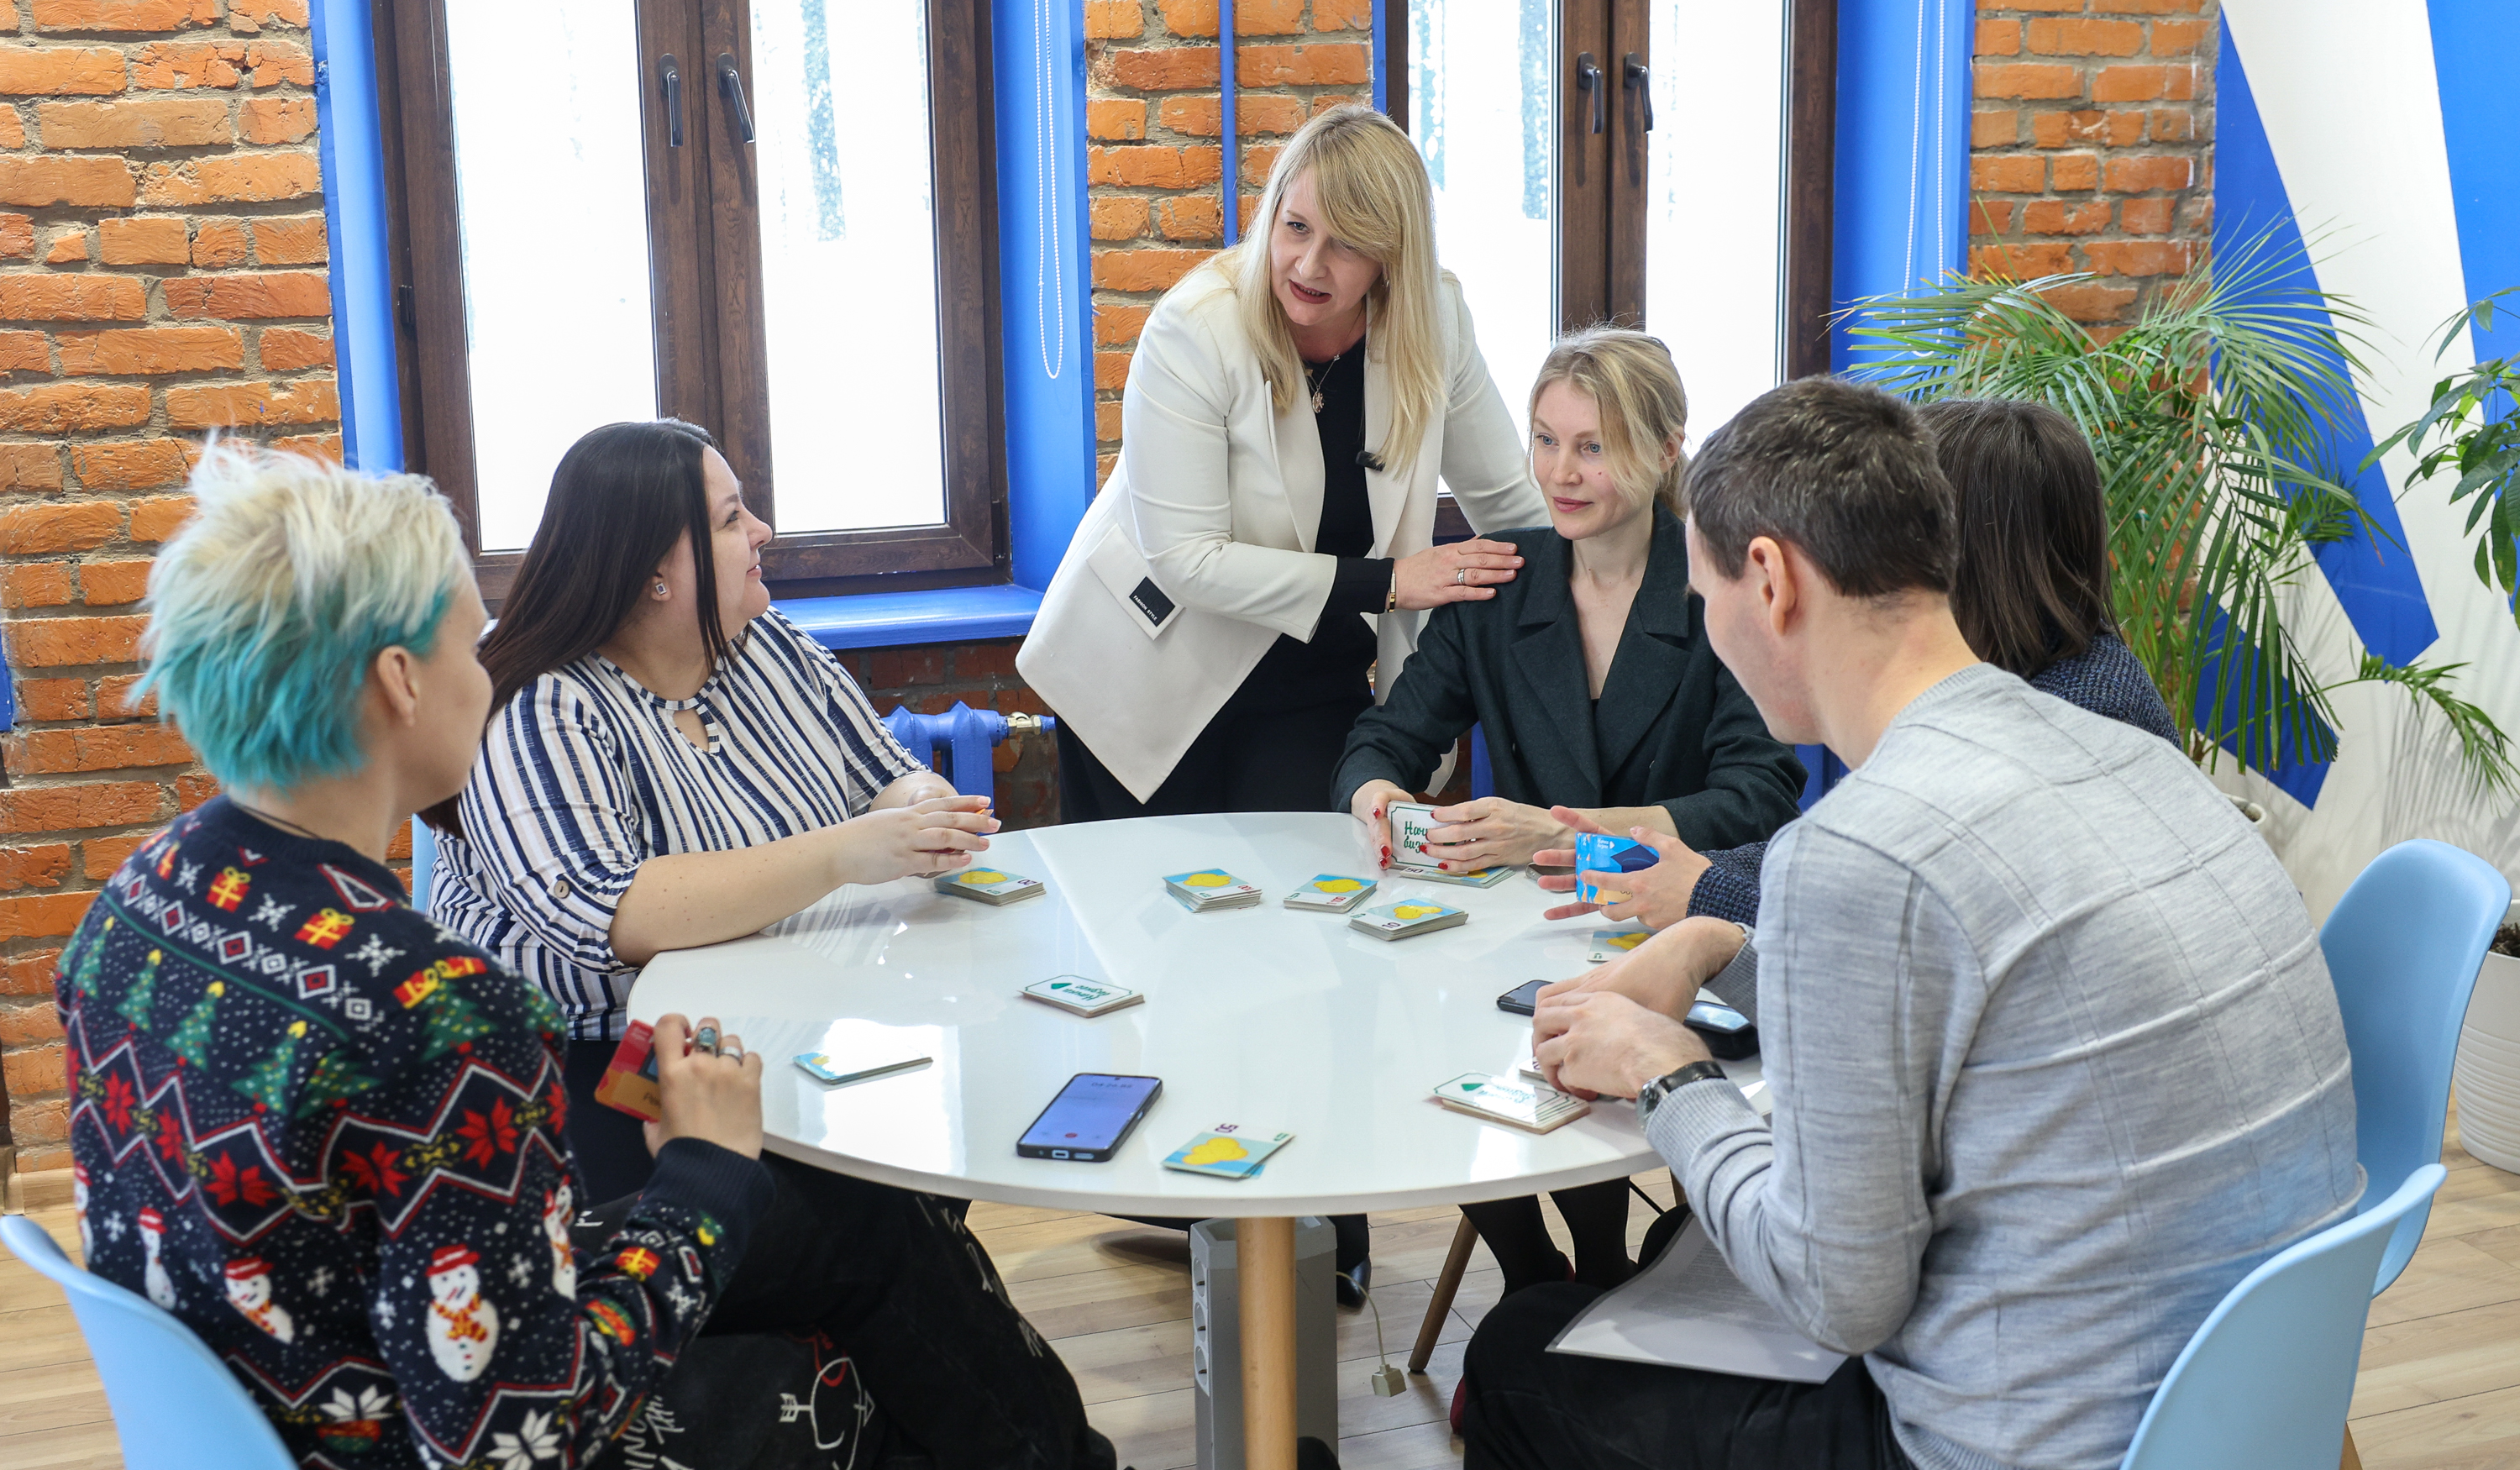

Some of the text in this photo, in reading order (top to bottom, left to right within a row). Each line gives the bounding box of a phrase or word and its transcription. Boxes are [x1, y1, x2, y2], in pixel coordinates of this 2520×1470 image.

[1133, 596, 1158, 621] FASHION STYLE
[1404, 821, 1428, 836] Нач
[1404, 836, 1426, 853] биз
